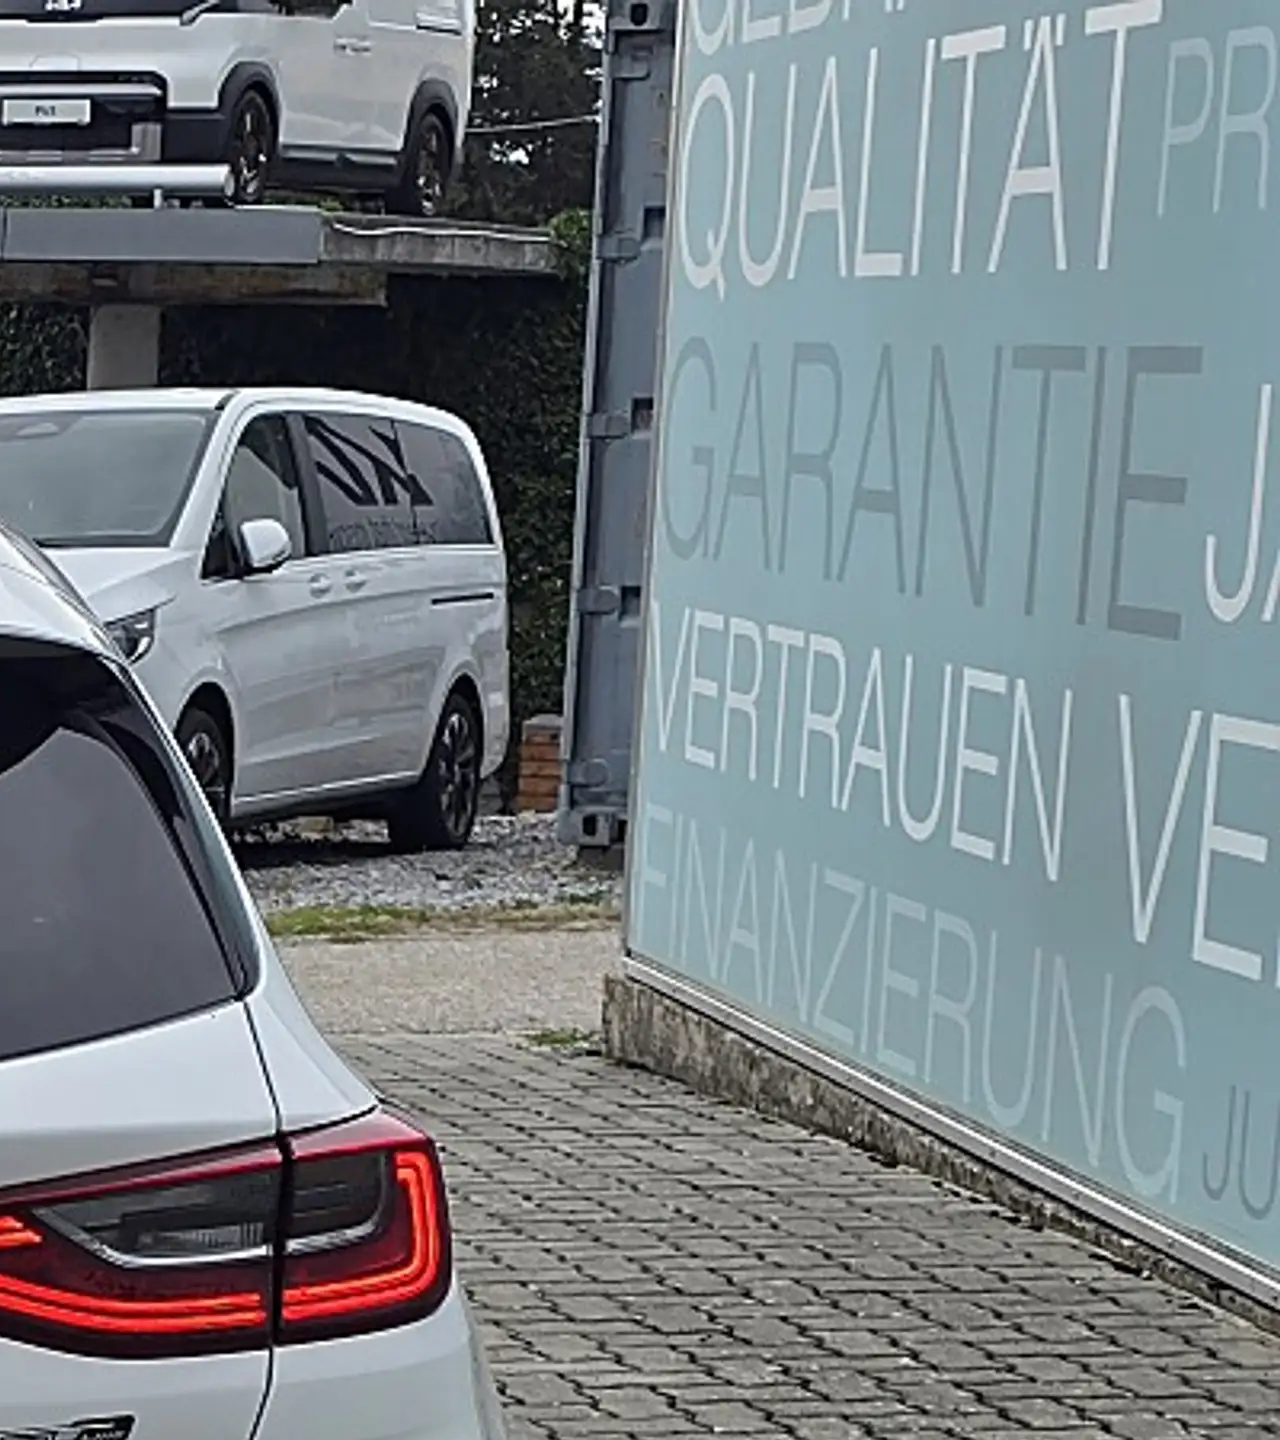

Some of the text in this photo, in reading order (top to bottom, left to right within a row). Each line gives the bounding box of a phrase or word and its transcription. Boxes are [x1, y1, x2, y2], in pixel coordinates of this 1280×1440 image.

[679, 0, 1277, 300] QUALITÄT PR
[661, 336, 1203, 640] GARANTIE
[648, 598, 1280, 988] VERTRAUEN VE
[640, 801, 1280, 1221] FINANZIERUNG JU
